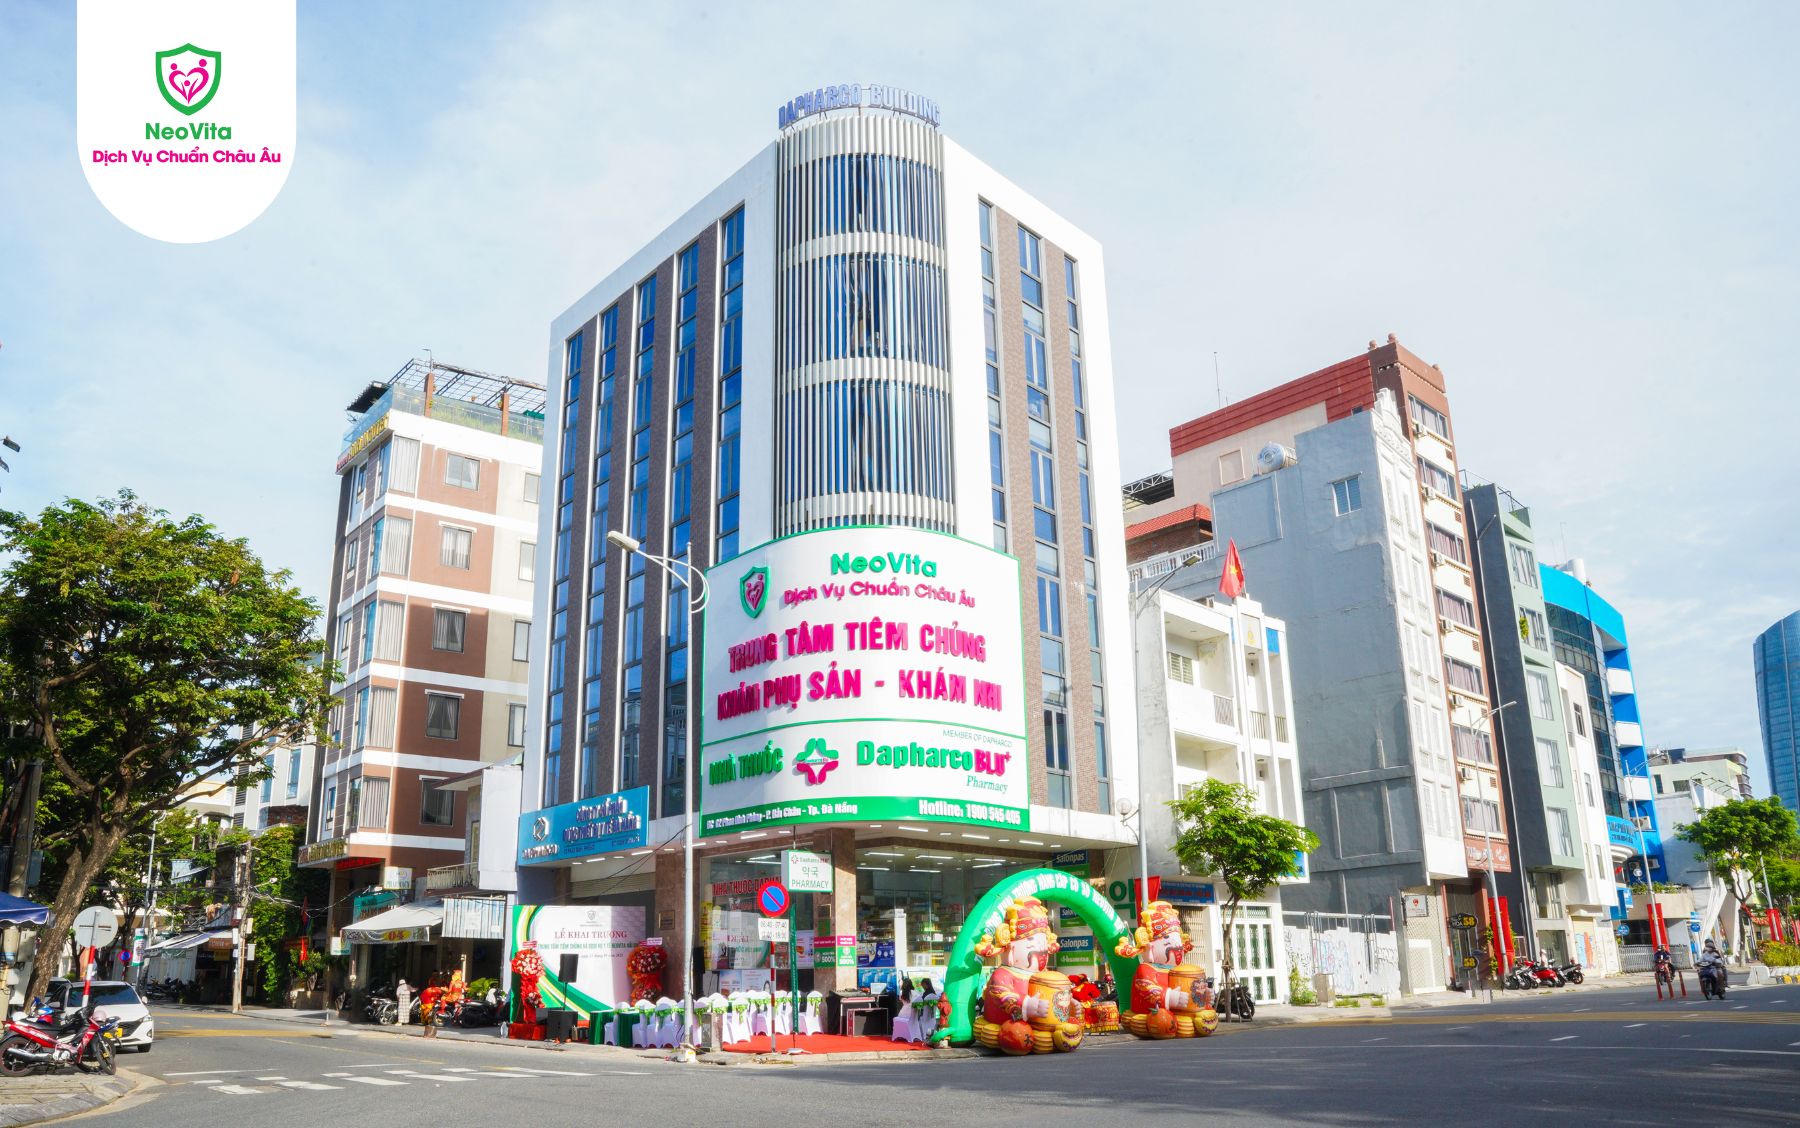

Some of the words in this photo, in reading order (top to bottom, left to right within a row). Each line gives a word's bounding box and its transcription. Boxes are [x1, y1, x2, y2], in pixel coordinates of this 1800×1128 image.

[778, 83, 863, 129] DAPHARCO
[870, 83, 940, 126] BUILDING
[831, 551, 938, 578] NeoVita
[784, 586, 818, 606] Dịch
[822, 582, 845, 601] Vụ
[850, 577, 910, 597] Chuẩn
[915, 583, 956, 603] Châu
[959, 588, 976, 608] Âu
[728, 633, 778, 673] TRUNG
[785, 620, 834, 657] TÂM
[845, 616, 909, 651] TIÊM
[919, 620, 986, 663] CHỦNG
[763, 673, 801, 710] PHỤ
[809, 660, 862, 699] SẢN
[898, 666, 967, 704] KHÁM
[973, 678, 1002, 712] NHI
[943, 729, 972, 740] MEMBER
[973, 733, 982, 742] OF
[709, 753, 737, 785] NHÀ
[738, 740, 784, 779] THUỐC
[966, 775, 1009, 794] Pharmacy
[966, 803, 987, 820] 1900
[801, 866, 819, 878] 약국
[791, 879, 829, 889] PHARMACY
[568, 931, 589, 939] KHAI
[1060, 938, 1089, 950] Salonpas
